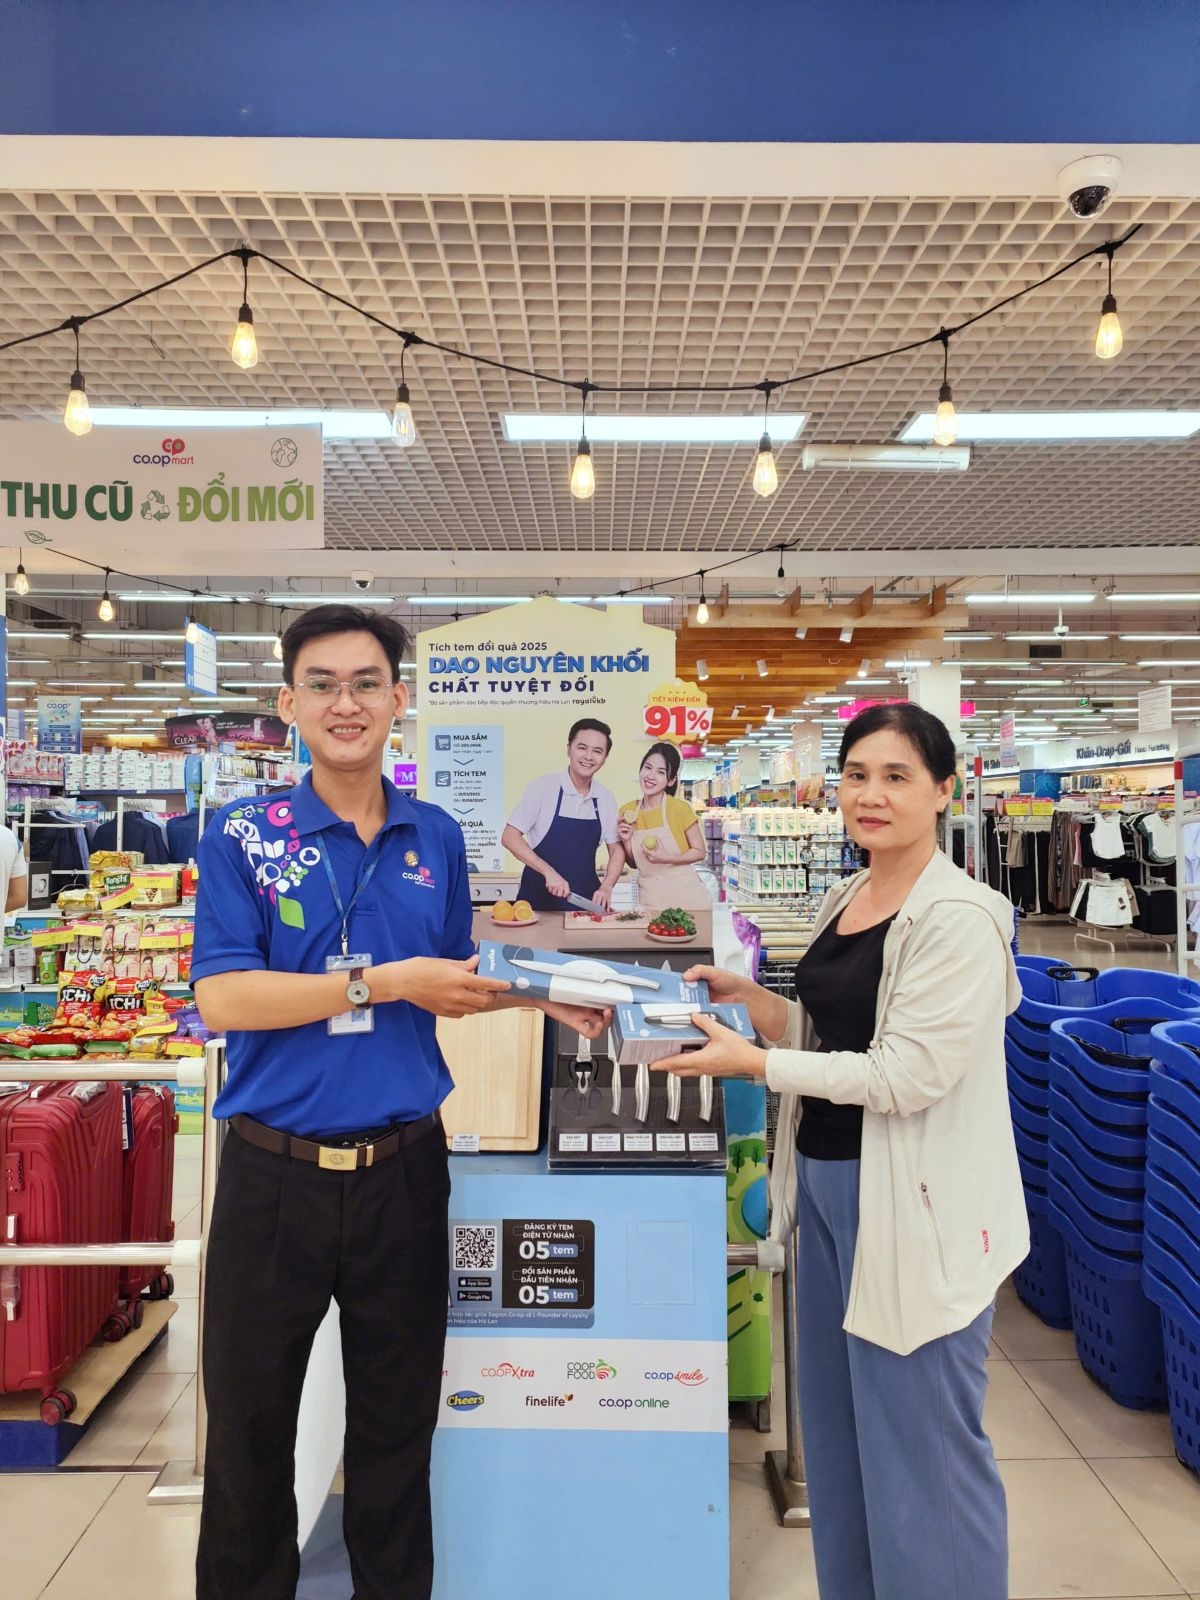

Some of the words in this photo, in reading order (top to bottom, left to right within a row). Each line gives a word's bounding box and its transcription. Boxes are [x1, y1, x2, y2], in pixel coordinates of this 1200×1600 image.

[0, 481, 77, 520] THU
[85, 480, 133, 522] CŨ
[177, 472, 240, 522] ĐỔI
[247, 478, 314, 522] MỚI
[429, 643, 451, 651] Tích
[454, 643, 474, 651] tem
[478, 640, 494, 651] đổi
[521, 642, 547, 650] 2025
[429, 656, 480, 673] DAO
[485, 651, 584, 673] NGUYÊN
[590, 647, 649, 673] KHỐI
[429, 675, 479, 693] CHẤT
[488, 677, 551, 695] TUYỆT
[560, 675, 594, 692] ĐỐI
[645, 705, 709, 737] 91%
[174, 736, 197, 745] CLEAR
[524, 1222, 545, 1230] ĐĂNG
[523, 1231, 540, 1239] ĐIỆN
[553, 1231, 574, 1240] NHẬN
[519, 1241, 550, 1259] 05
[553, 1246, 574, 1254] tem
[519, 1285, 549, 1304] 05
[553, 1290, 574, 1299] tem
[567, 1370, 595, 1379] FOOD
[447, 1395, 484, 1406] Cheers
[526, 1396, 565, 1406] finelife
[599, 1398, 633, 1409] co.op
[634, 1398, 669, 1408] online
